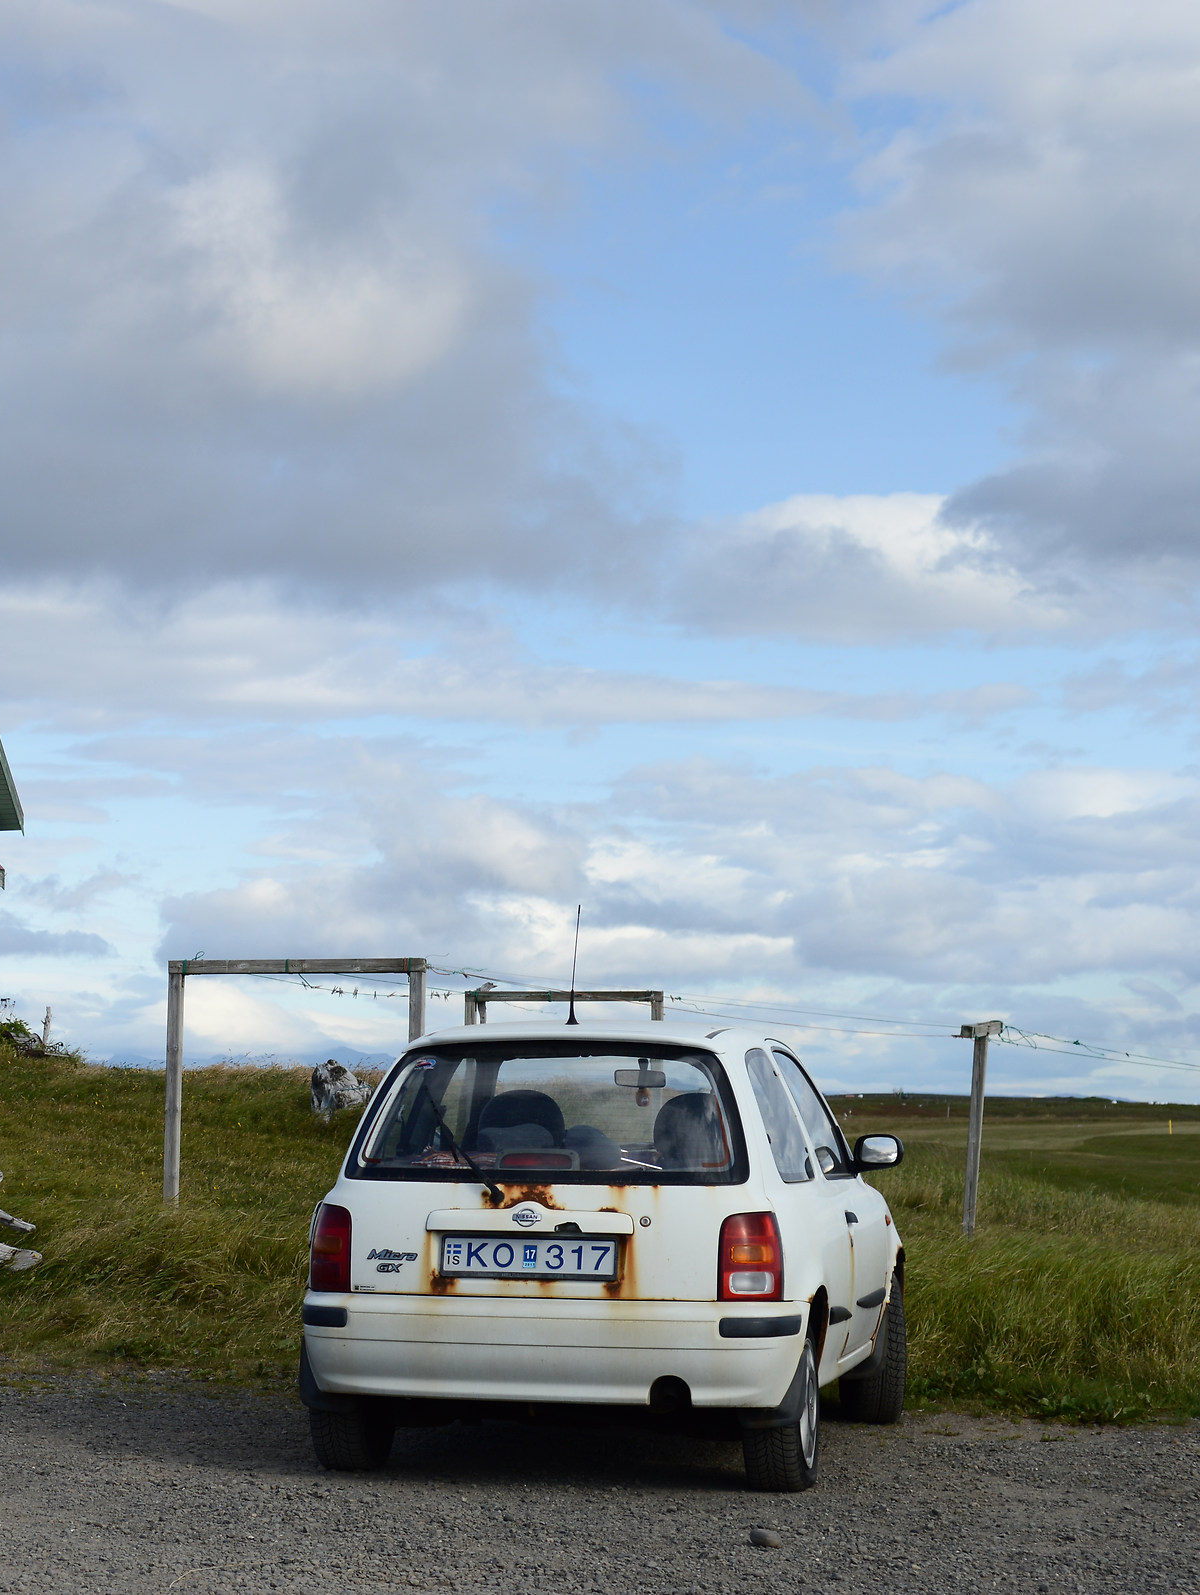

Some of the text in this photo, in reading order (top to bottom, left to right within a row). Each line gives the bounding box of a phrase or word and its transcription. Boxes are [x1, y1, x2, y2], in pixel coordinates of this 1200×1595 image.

[366, 1248, 418, 1261] Micra
[447, 1255, 460, 1265] IS
[466, 1242, 611, 1271] KO 317
[525, 1249, 536, 1260] 17
[376, 1262, 404, 1273] GX
